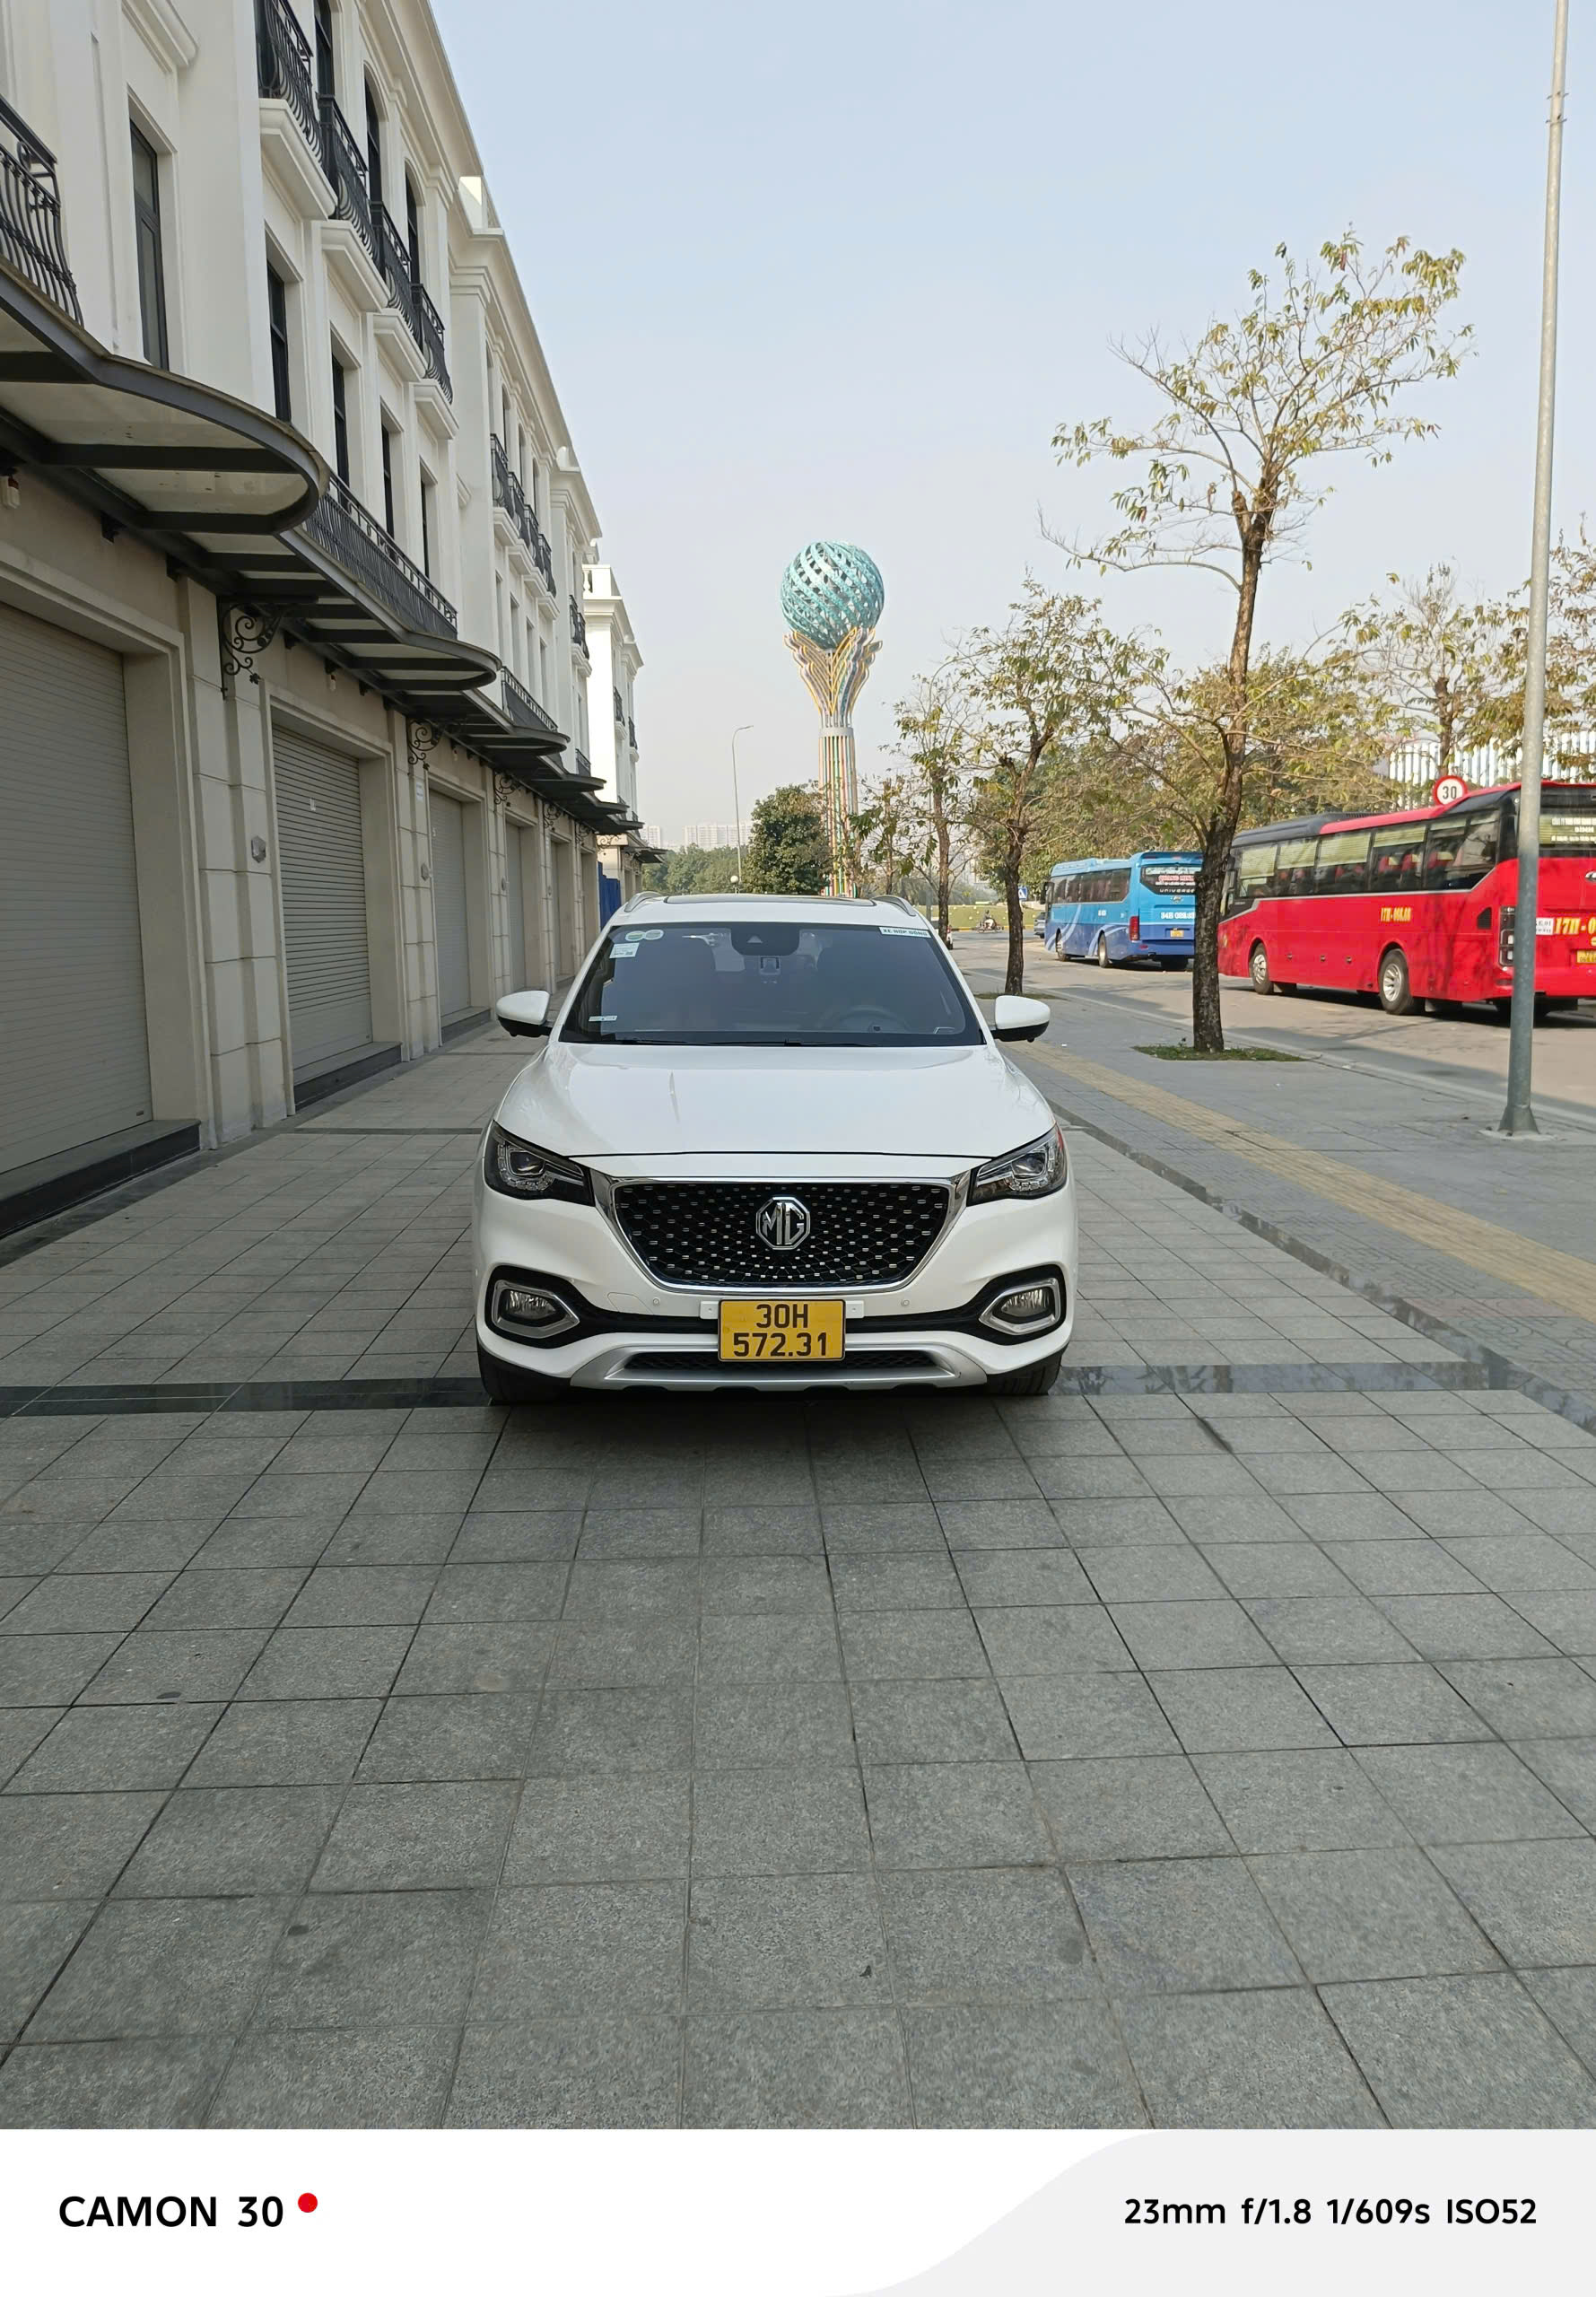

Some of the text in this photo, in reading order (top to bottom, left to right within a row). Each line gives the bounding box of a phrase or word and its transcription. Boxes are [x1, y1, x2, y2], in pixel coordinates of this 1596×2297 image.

[1443, 786, 1457, 799] 30
[762, 1201, 805, 1245] MG
[756, 1304, 808, 1329] 30H
[733, 1332, 826, 1357] 572.31
